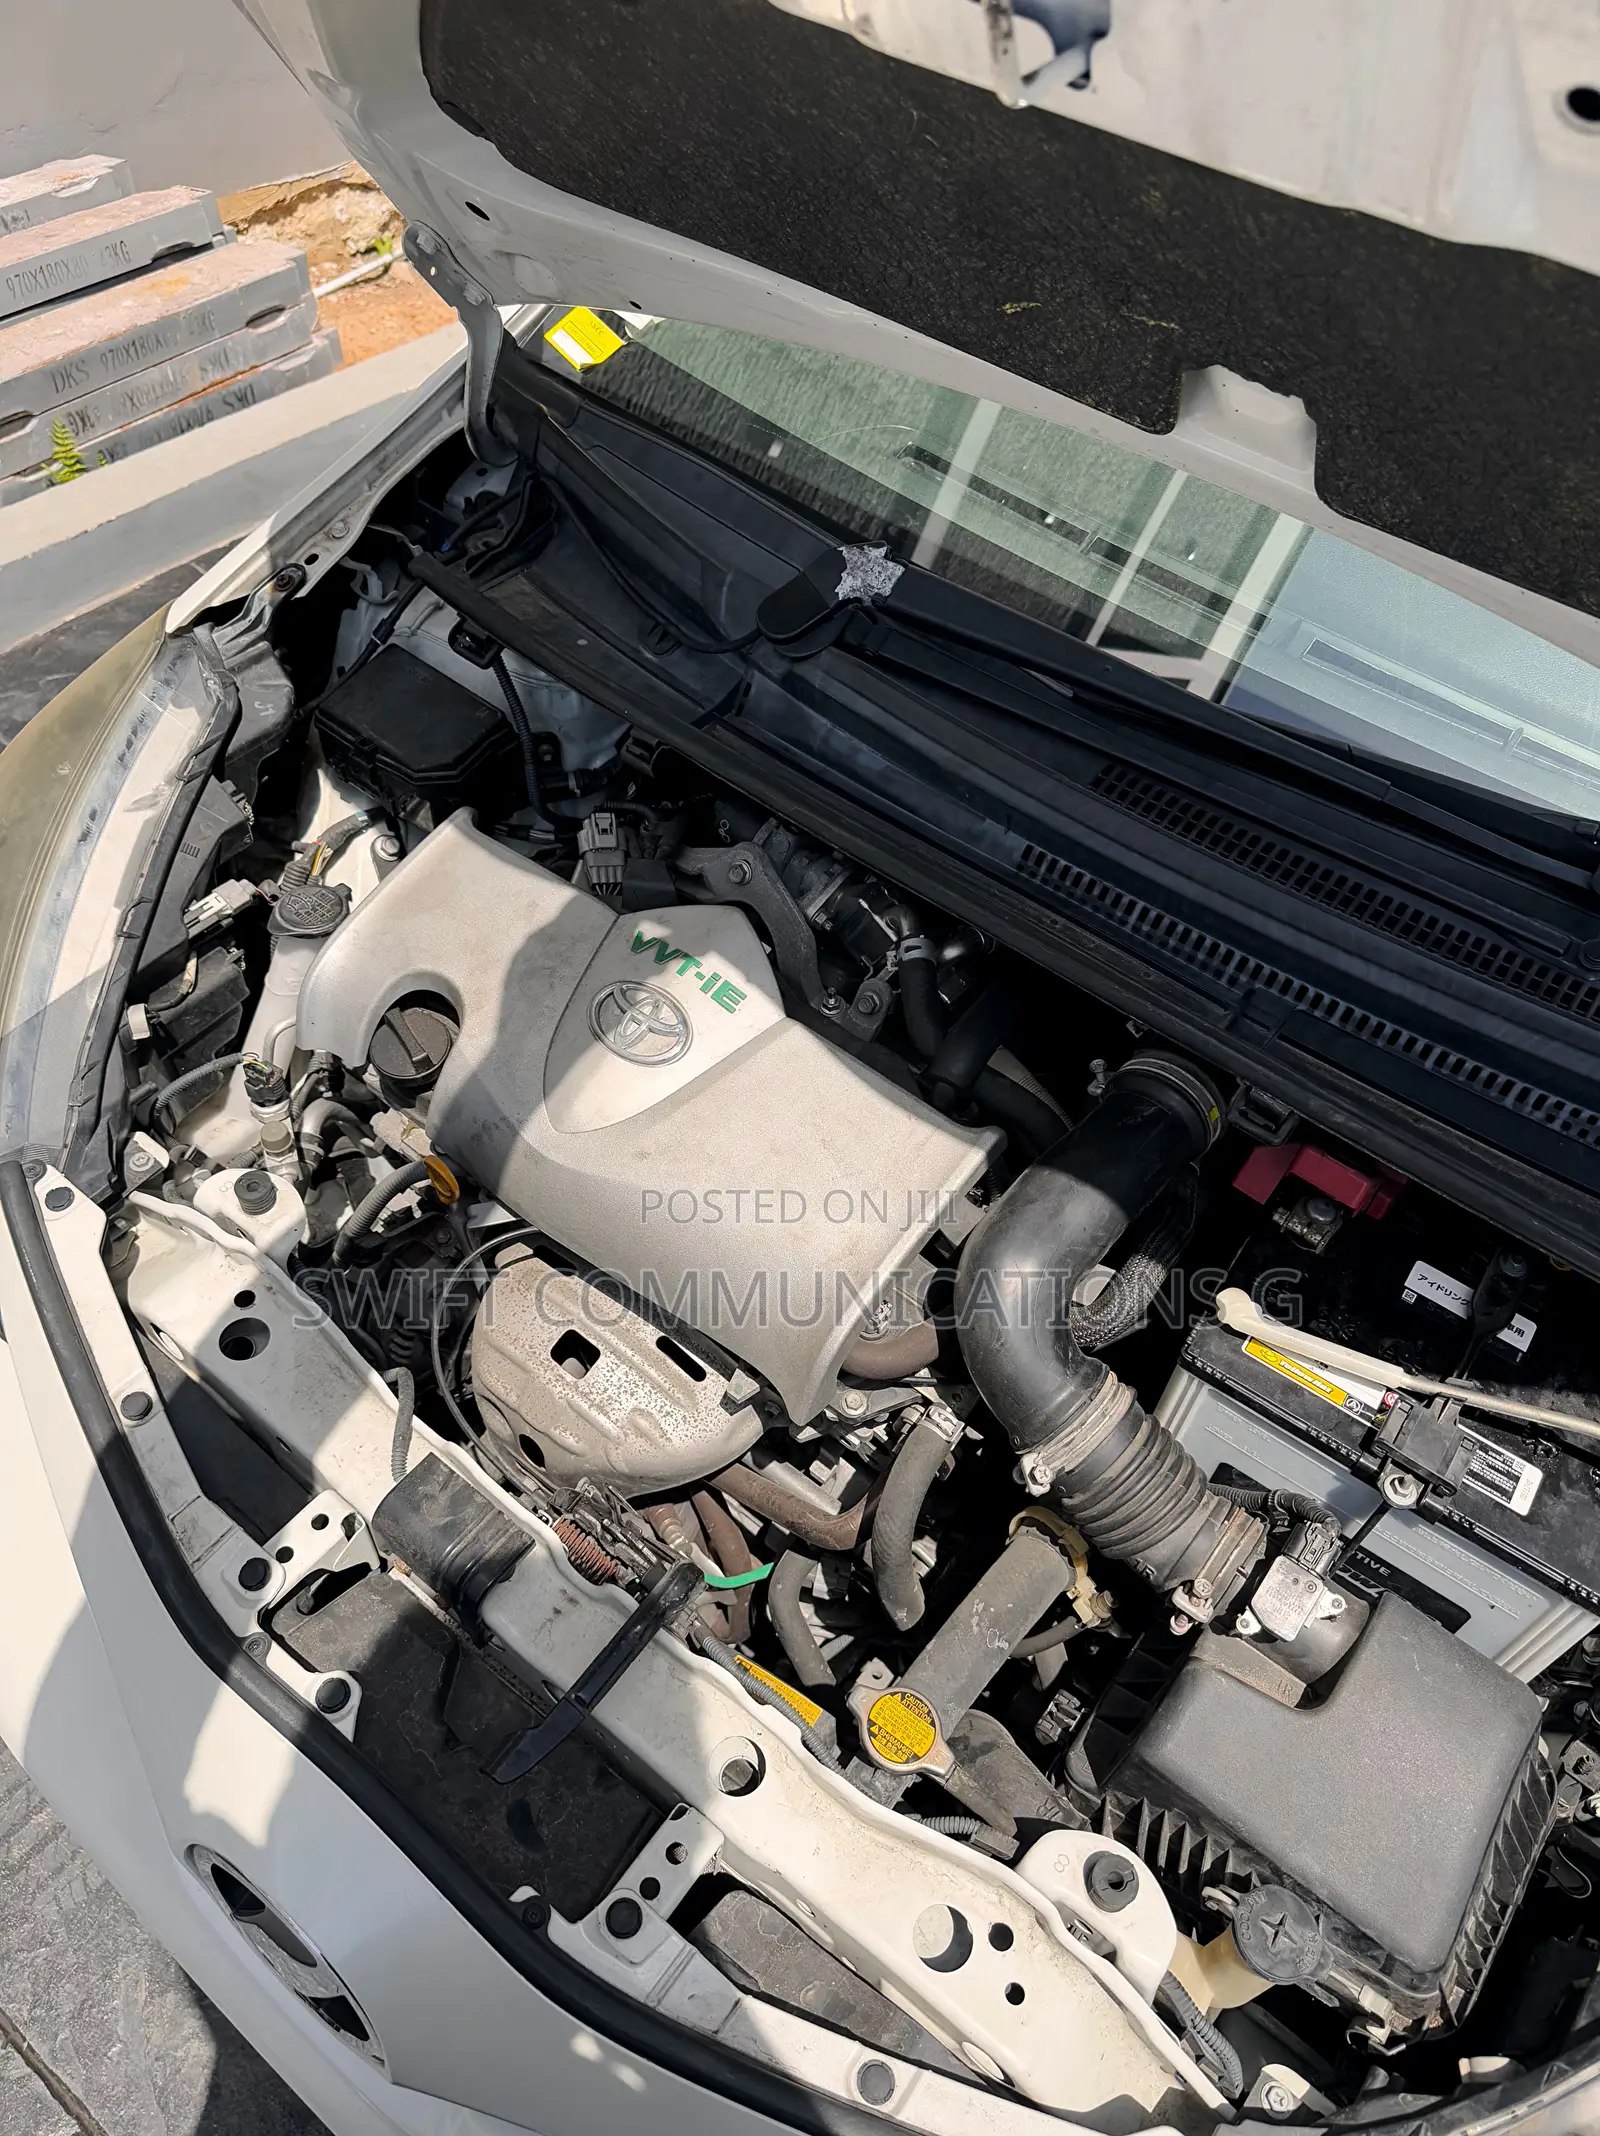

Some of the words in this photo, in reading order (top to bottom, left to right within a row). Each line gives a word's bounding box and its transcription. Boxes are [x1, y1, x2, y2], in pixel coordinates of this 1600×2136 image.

[50, 359, 90, 394] DKS
[901, 1699, 933, 1724] ATTENTION
[904, 1693, 930, 1714] CAUTION
